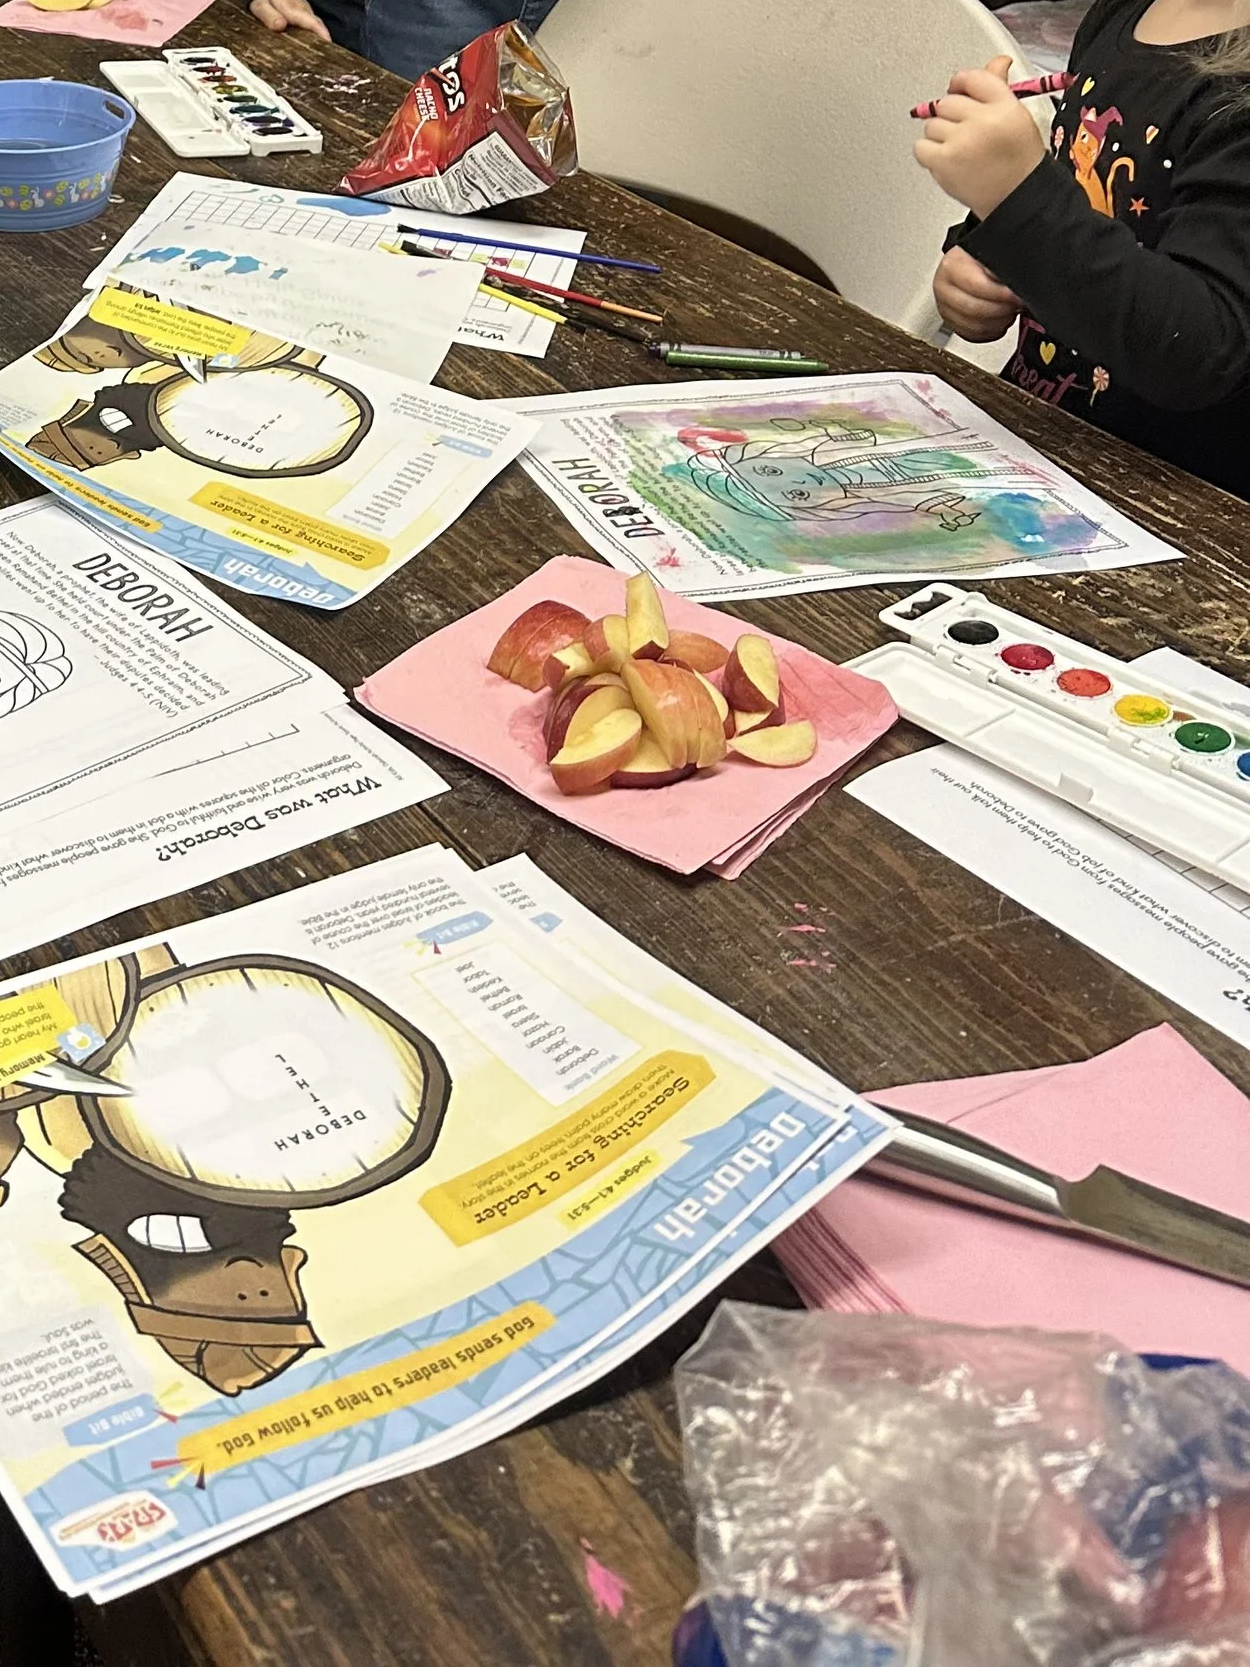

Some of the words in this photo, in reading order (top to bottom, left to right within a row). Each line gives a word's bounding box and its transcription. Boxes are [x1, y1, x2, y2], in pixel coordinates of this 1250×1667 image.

[424, 87, 439, 121] NACHO
[205, 428, 263, 453] DEBORAH
[553, 458, 666, 540] DEBORAH
[210, 500, 255, 521] Leader
[270, 523, 292, 534] for
[294, 530, 365, 561] Searching
[216, 558, 335, 608] Deborah
[72, 553, 212, 641] DEBORAH
[6, 531, 23, 544] Now
[95, 596, 108, 607] the
[109, 607, 127, 621] wife
[182, 660, 199, 673] was
[199, 672, 229, 695] leading
[15, 581, 37, 595] went
[33, 595, 45, 603] up
[45, 602, 55, 610] to
[54, 609, 70, 620] her
[69, 621, 79, 629] to
[79, 628, 98, 643] have
[98, 643, 120, 658] their
[119, 659, 153, 685] disputes
[52, 580, 67, 591] She
[67, 590, 86, 604] held
[84, 603, 109, 620] court
[105, 620, 130, 637] under
[130, 637, 145, 648] the
[145, 648, 165, 663] Palm
[165, 663, 180, 671] of
[177, 672, 215, 700] Deborah
[78, 613, 92, 624] the
[105, 634, 137, 657] country
[185, 694, 205, 706] and
[99, 660, 128, 682] Judges
[148, 698, 178, 717] (NIV)
[271, 771, 301, 784] Color
[317, 761, 362, 779] Deborah
[238, 786, 256, 794] the
[255, 781, 270, 791] all
[273, 781, 295, 794] very
[295, 776, 317, 786] was
[314, 776, 381, 803] What
[198, 792, 237, 807] squares
[226, 800, 245, 812] and
[246, 792, 271, 802] wise
[971, 793, 992, 807] talk
[174, 805, 198, 817] with
[189, 807, 228, 824] faithful
[264, 799, 312, 819] was
[991, 806, 1017, 824] them
[147, 815, 165, 826] dot
[108, 825, 135, 840] them
[127, 832, 149, 842] She
[155, 815, 265, 861] Deborah?
[1017, 823, 1041, 841] help
[50, 838, 95, 856] discover
[100, 837, 126, 851] gave
[21, 853, 48, 866] what
[60, 845, 99, 864] people
[1051, 848, 1079, 866] God
[6, 860, 59, 881] messages
[1080, 865, 1107, 884] from
[1107, 879, 1163, 921] messages
[1163, 921, 1209, 953] people
[556, 1047, 598, 1075] Deborah
[593, 1076, 689, 1149] Searching
[274, 1109, 366, 1150] DEBORAH
[565, 1149, 595, 1171] for
[613, 1155, 651, 1185] Judges
[544, 1170, 560, 1181] a
[653, 1111, 807, 1242] Deborah
[474, 1182, 546, 1223] Leader
[503, 1316, 534, 1338] God
[455, 1333, 502, 1362] sends
[392, 1357, 456, 1388] leaders
[371, 1382, 392, 1396] to
[334, 1390, 372, 1410] help
[311, 1404, 333, 1418] us
[257, 1412, 310, 1439] follow
[216, 1432, 254, 1455] God.
